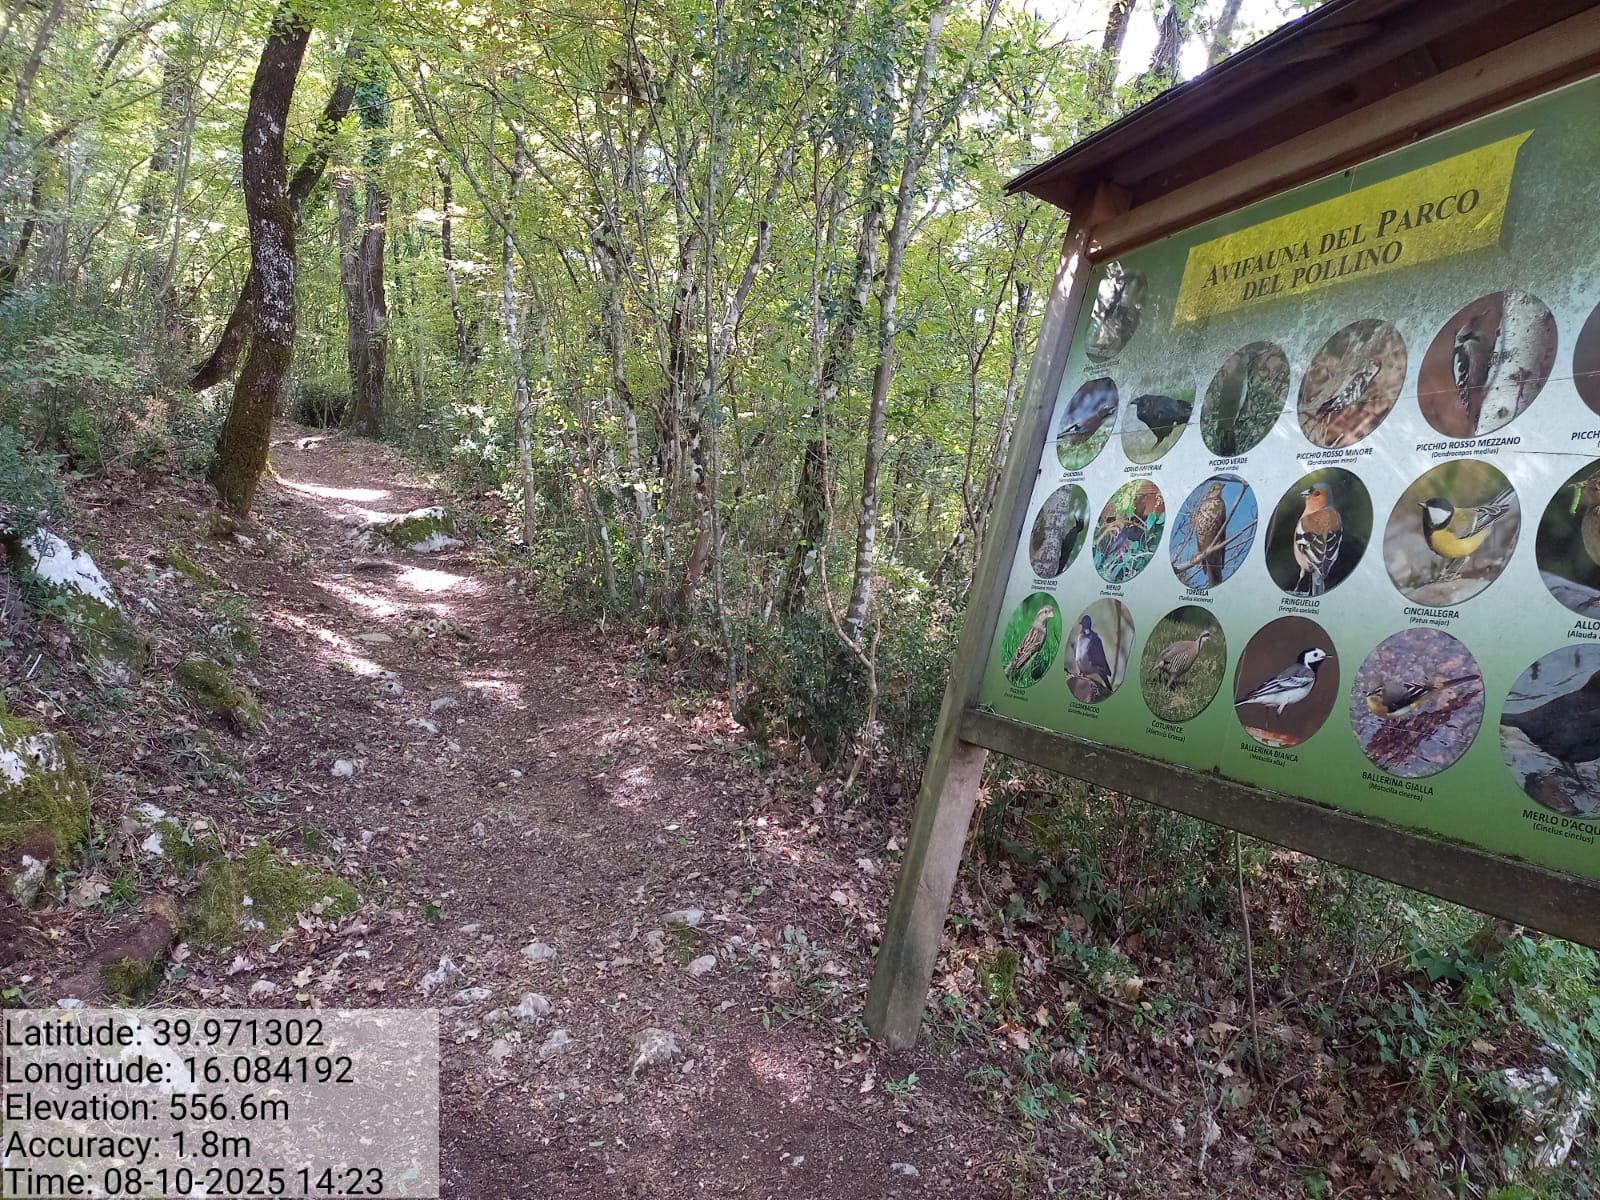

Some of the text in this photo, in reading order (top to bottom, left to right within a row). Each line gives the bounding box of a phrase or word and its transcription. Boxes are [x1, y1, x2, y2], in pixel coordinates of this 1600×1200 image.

[1202, 189, 1480, 288] AVIFAUNA DEL PARCO
[1242, 241, 1403, 300] DEL POLLINO
[1416, 437, 1521, 451] PICCHIO ROSSO MEZZANO
[1296, 447, 1373, 460] PICCHIO ROSSO MINORE
[1281, 597, 1320, 608] FRINGUELLO
[1403, 607, 1460, 618] CINCIALLEGRA
[1152, 720, 1184, 734] COTURNICE
[1240, 742, 1298, 762] BALLERINA BIANCA
[1362, 771, 1434, 795] BALLERINA GIALLA
[1522, 809, 1558, 825] MERLO
[1533, 822, 1594, 845] (Cinclus cinclus)
